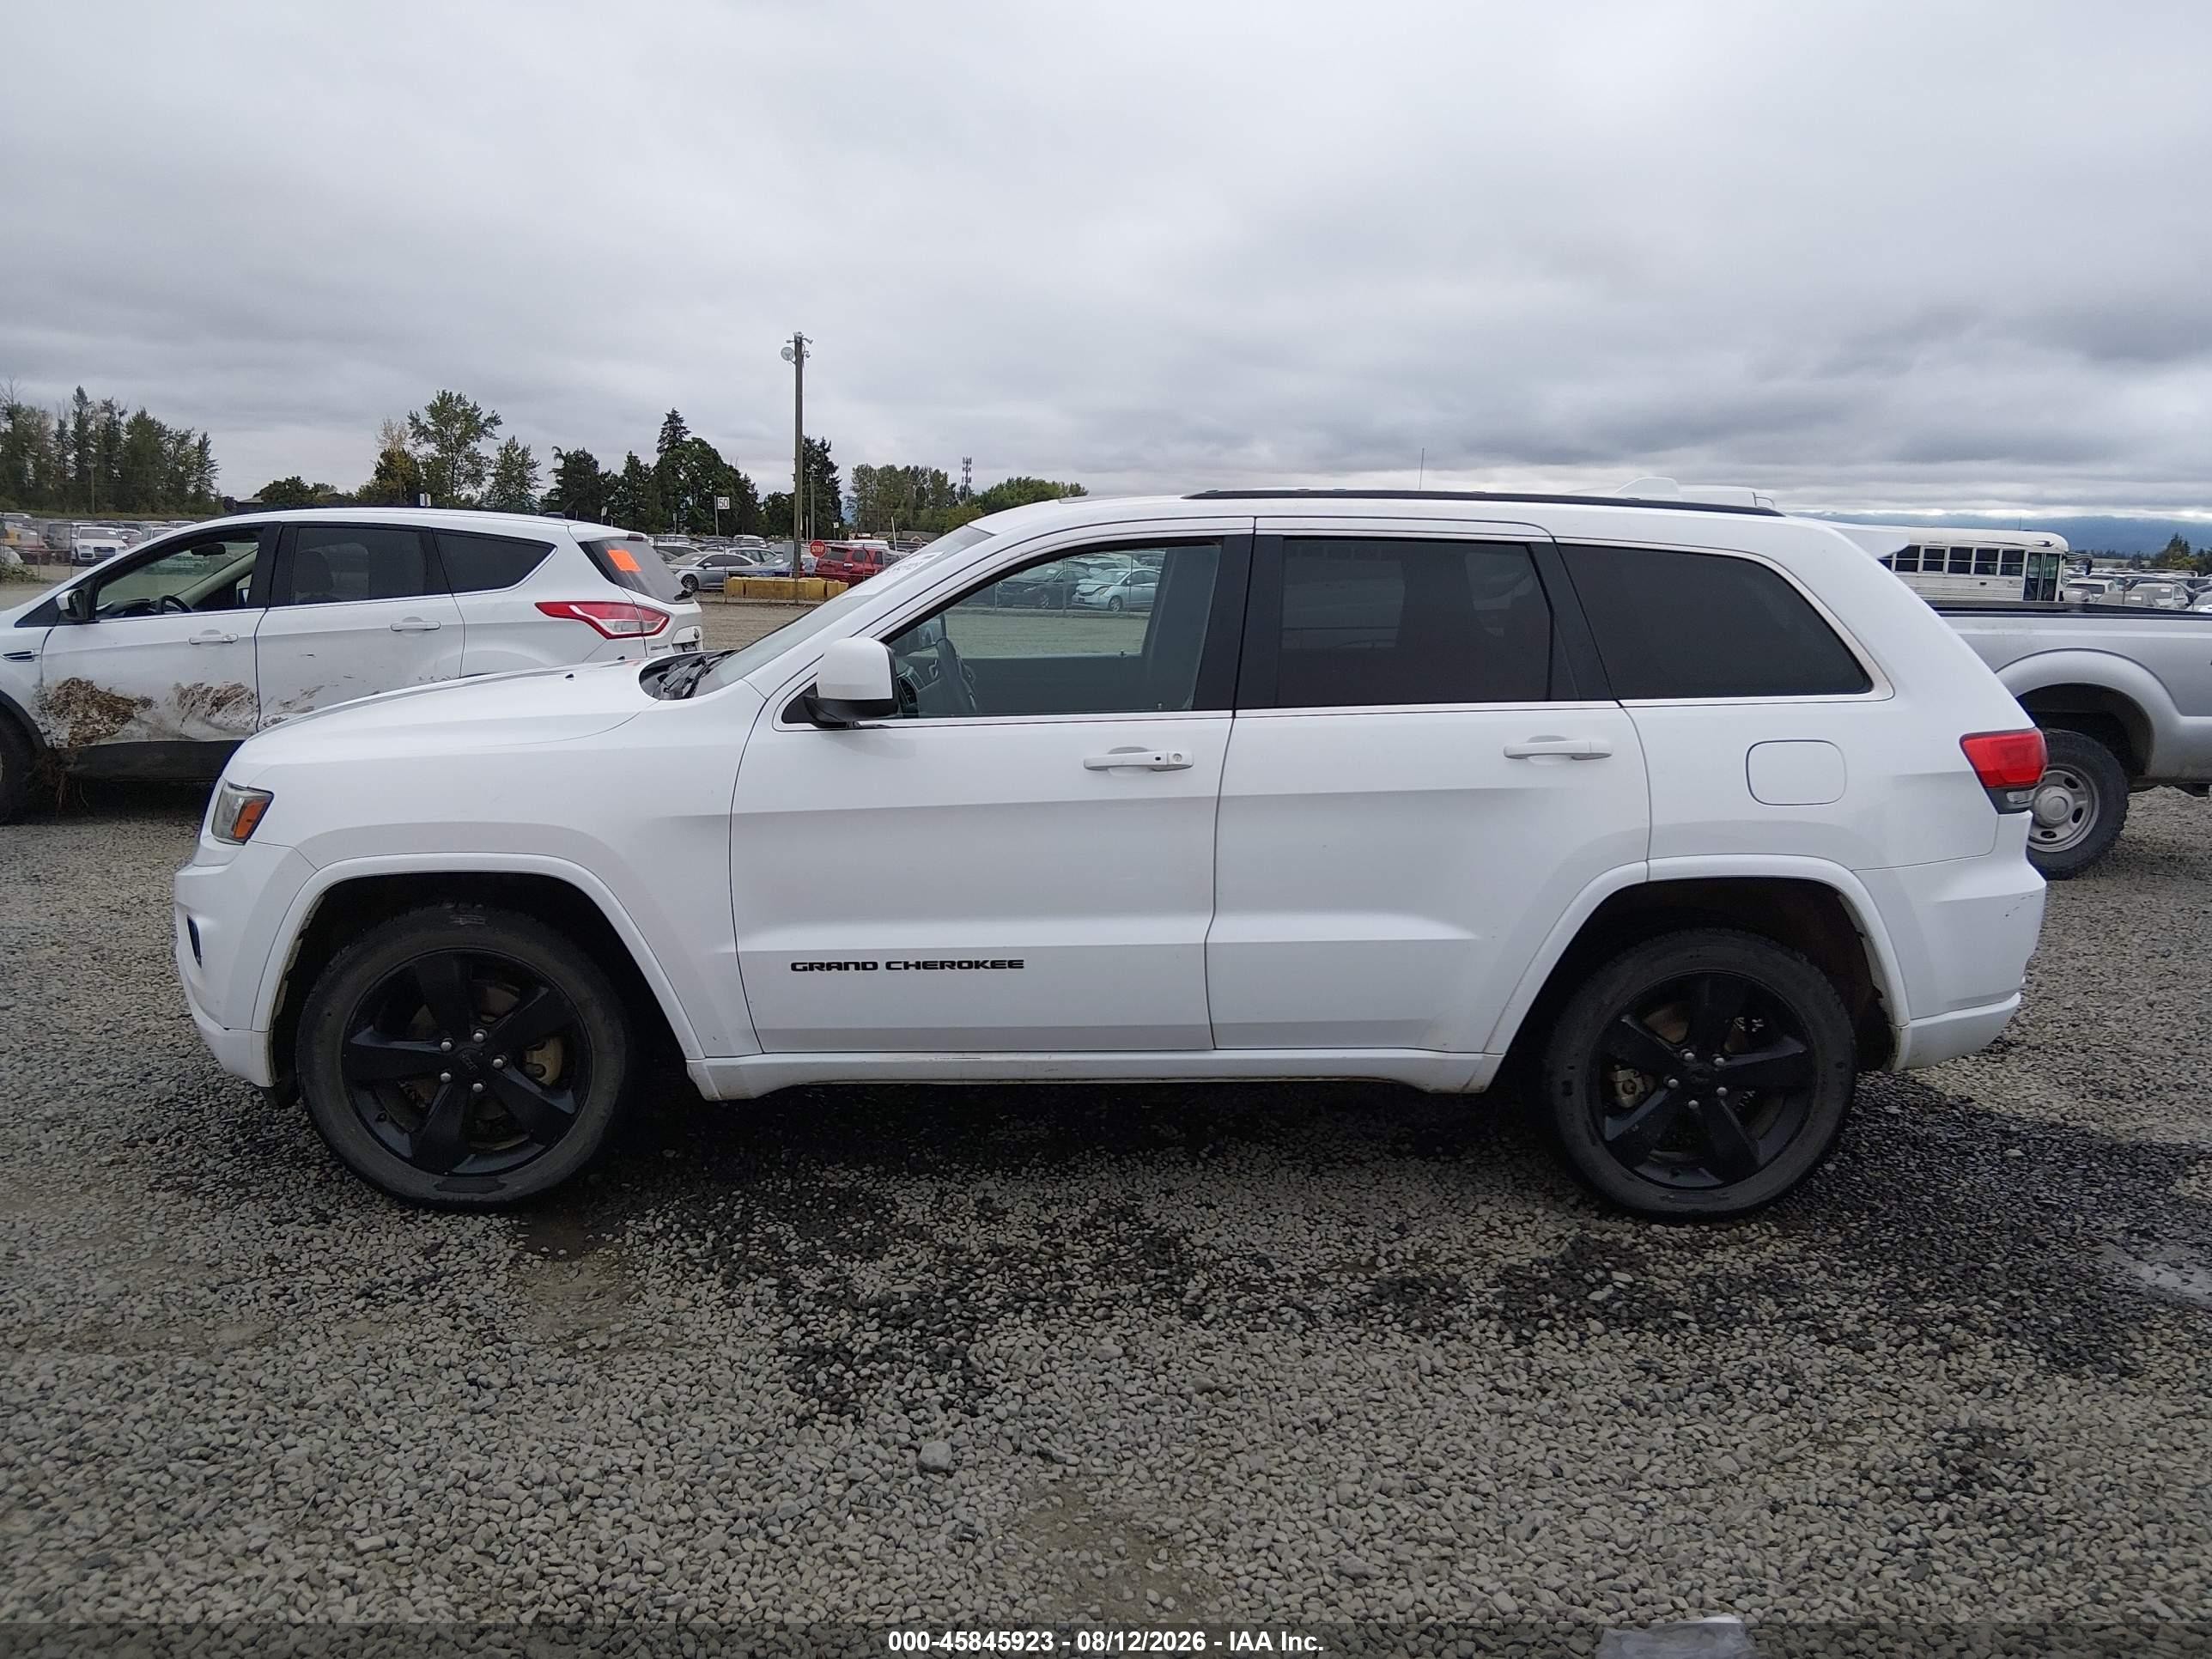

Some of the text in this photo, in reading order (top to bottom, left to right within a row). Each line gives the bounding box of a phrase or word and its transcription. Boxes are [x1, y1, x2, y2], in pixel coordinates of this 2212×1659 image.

[718, 497, 729, 508] 50
[790, 959, 1024, 972] GRAND CHEROKEE
